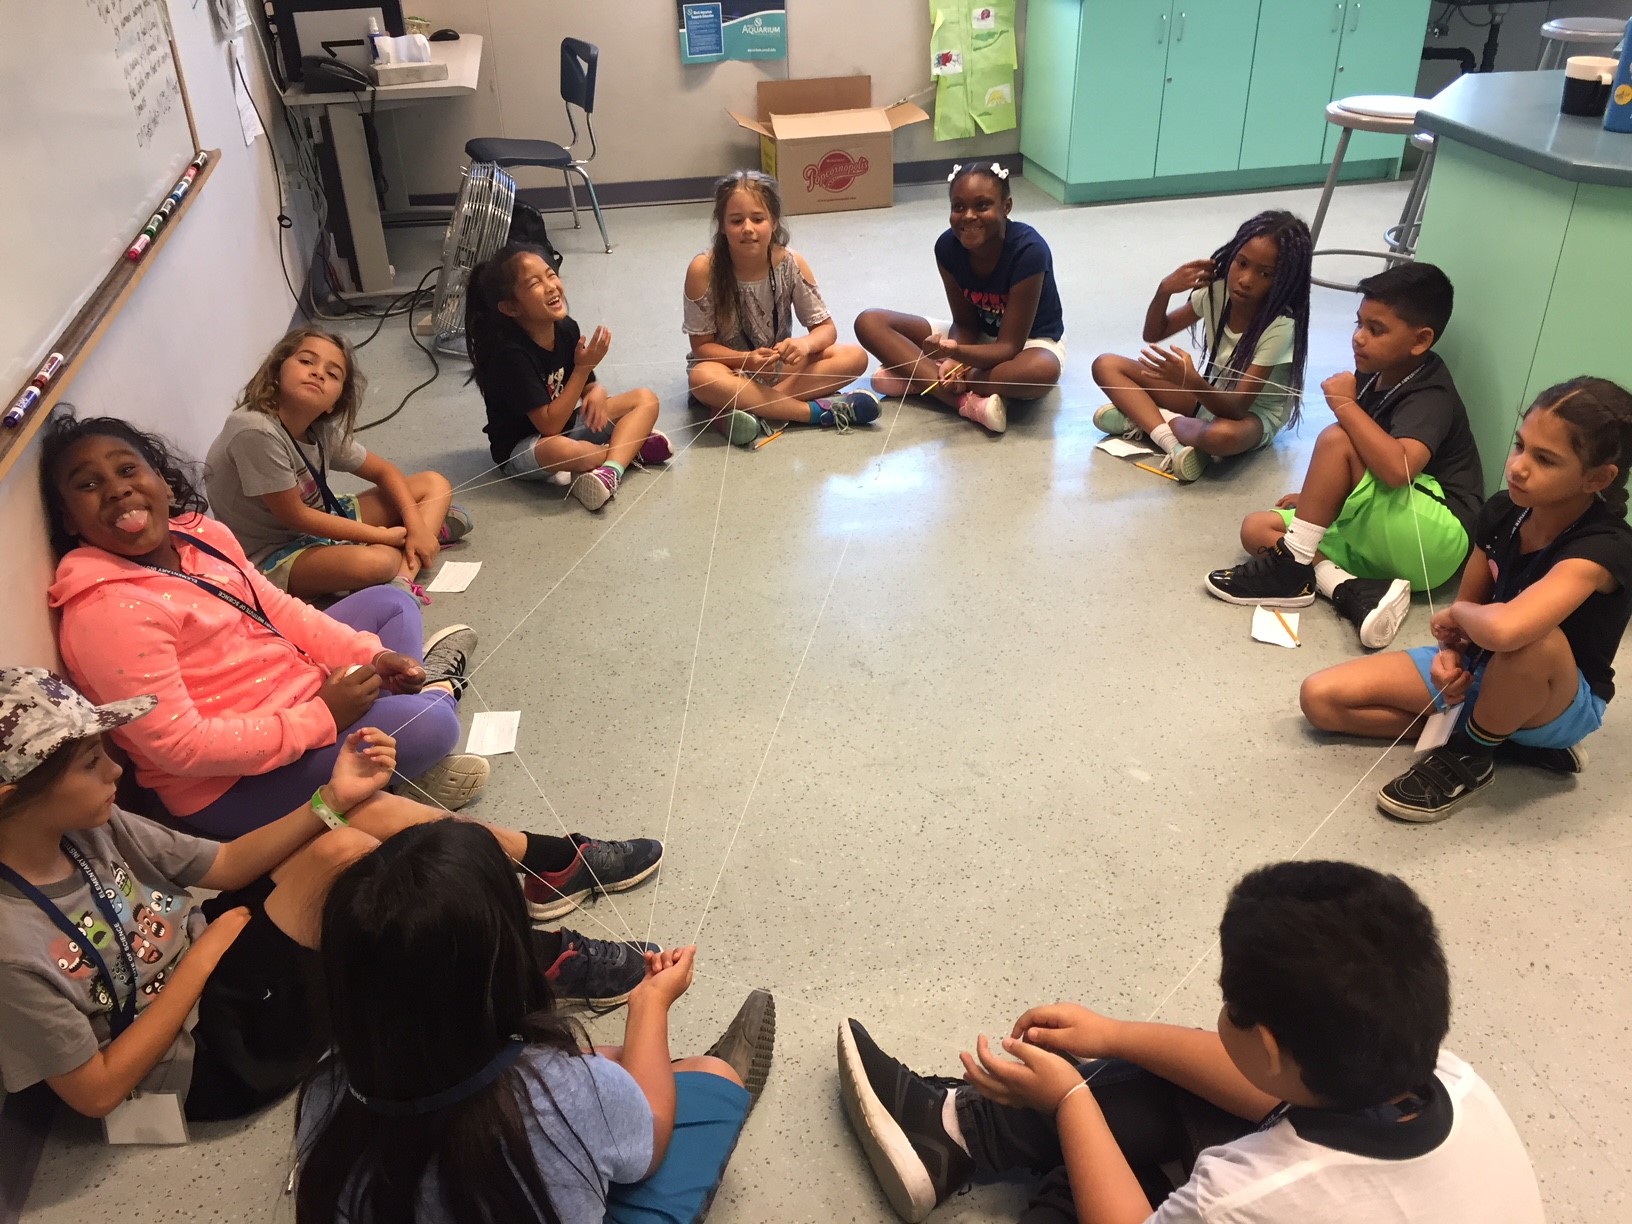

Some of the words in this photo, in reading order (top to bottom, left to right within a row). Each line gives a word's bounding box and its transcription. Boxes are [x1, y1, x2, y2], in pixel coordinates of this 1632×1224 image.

[742, 25, 780, 34] AQUARIUM
[803, 156, 869, 192] Popcornopolis
[218, 590, 240, 606] SCIENCE
[78, 860, 105, 899] ELEMENTARY
[114, 922, 130, 952] SCIENCE
